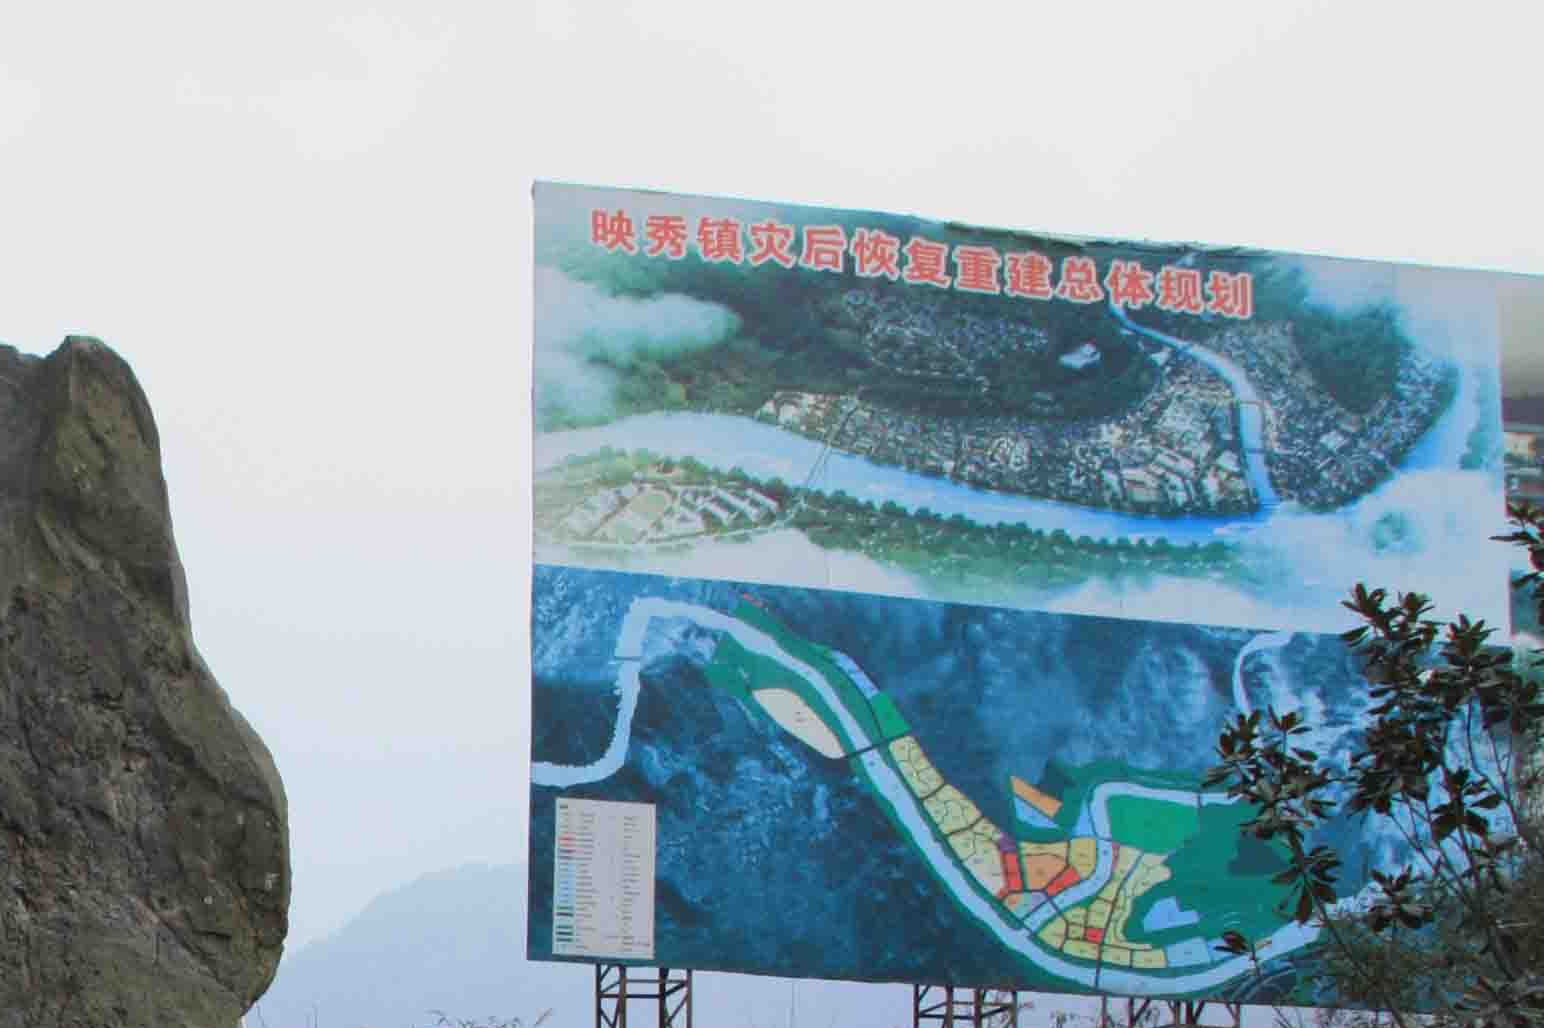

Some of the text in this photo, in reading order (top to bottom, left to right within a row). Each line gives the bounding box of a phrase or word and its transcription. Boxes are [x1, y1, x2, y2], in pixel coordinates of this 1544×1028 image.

[591, 210, 1254, 317] 映秀镇灾后恢复重建总体规划
